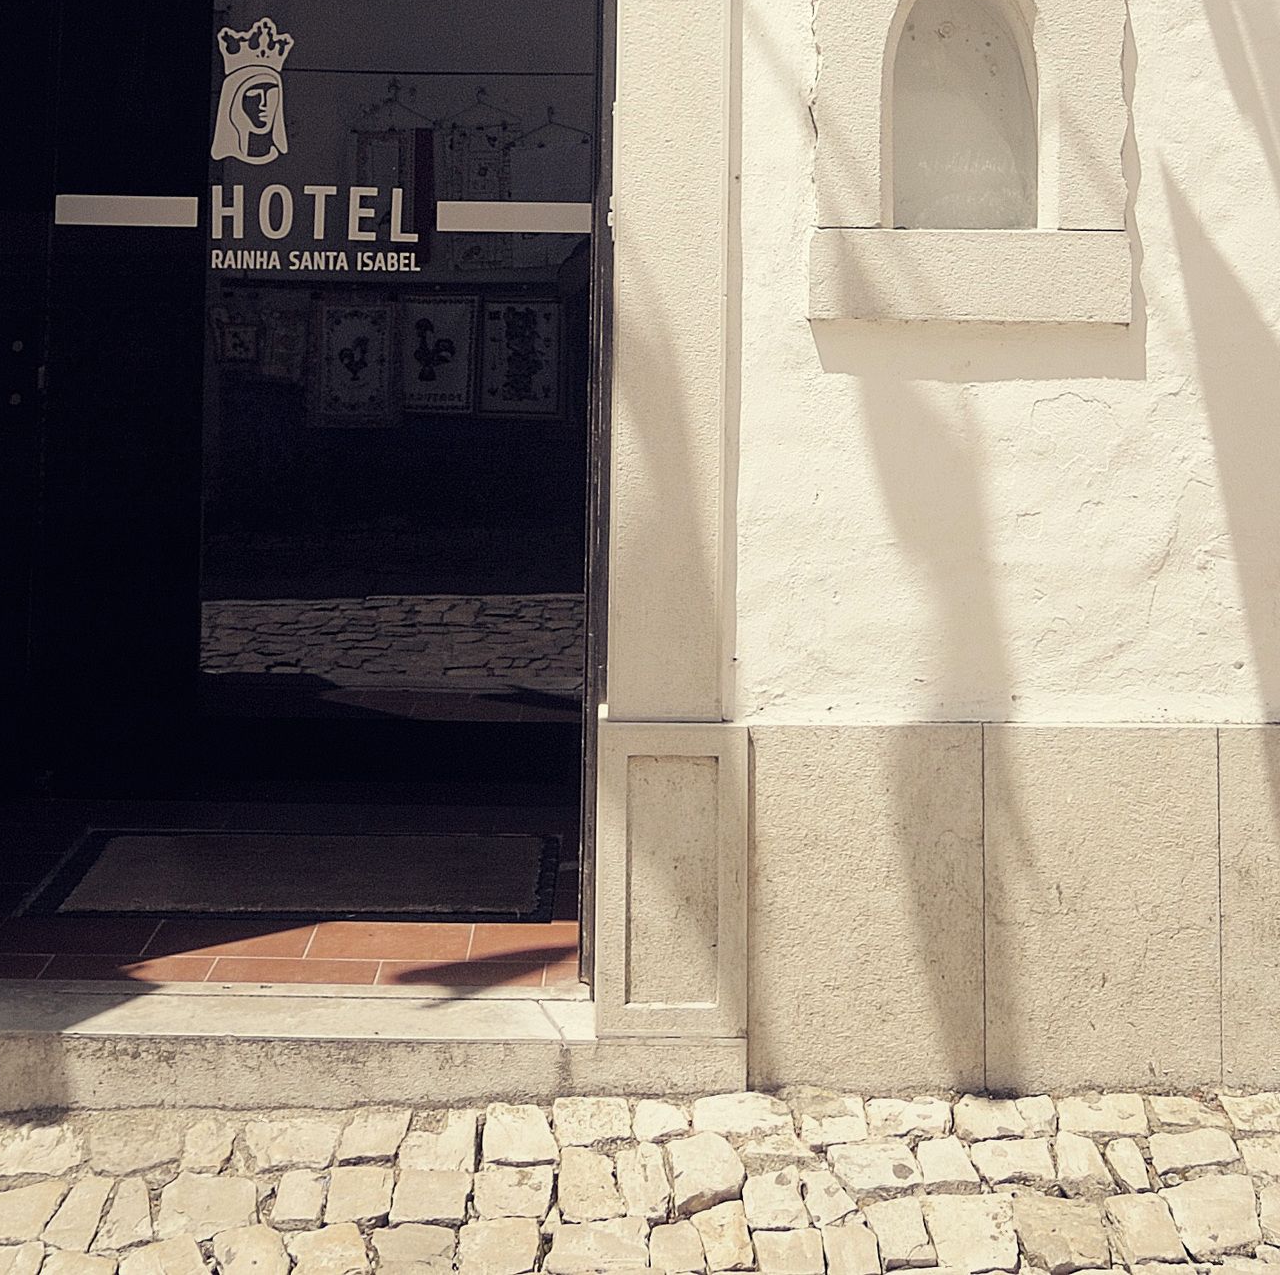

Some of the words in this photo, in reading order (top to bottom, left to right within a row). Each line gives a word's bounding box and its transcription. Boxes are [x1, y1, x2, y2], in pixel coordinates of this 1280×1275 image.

[211, 184, 419, 243] HOTEL
[211, 249, 281, 270] RAINHA
[289, 251, 349, 271] SANTA
[357, 252, 421, 272] ISABEL
